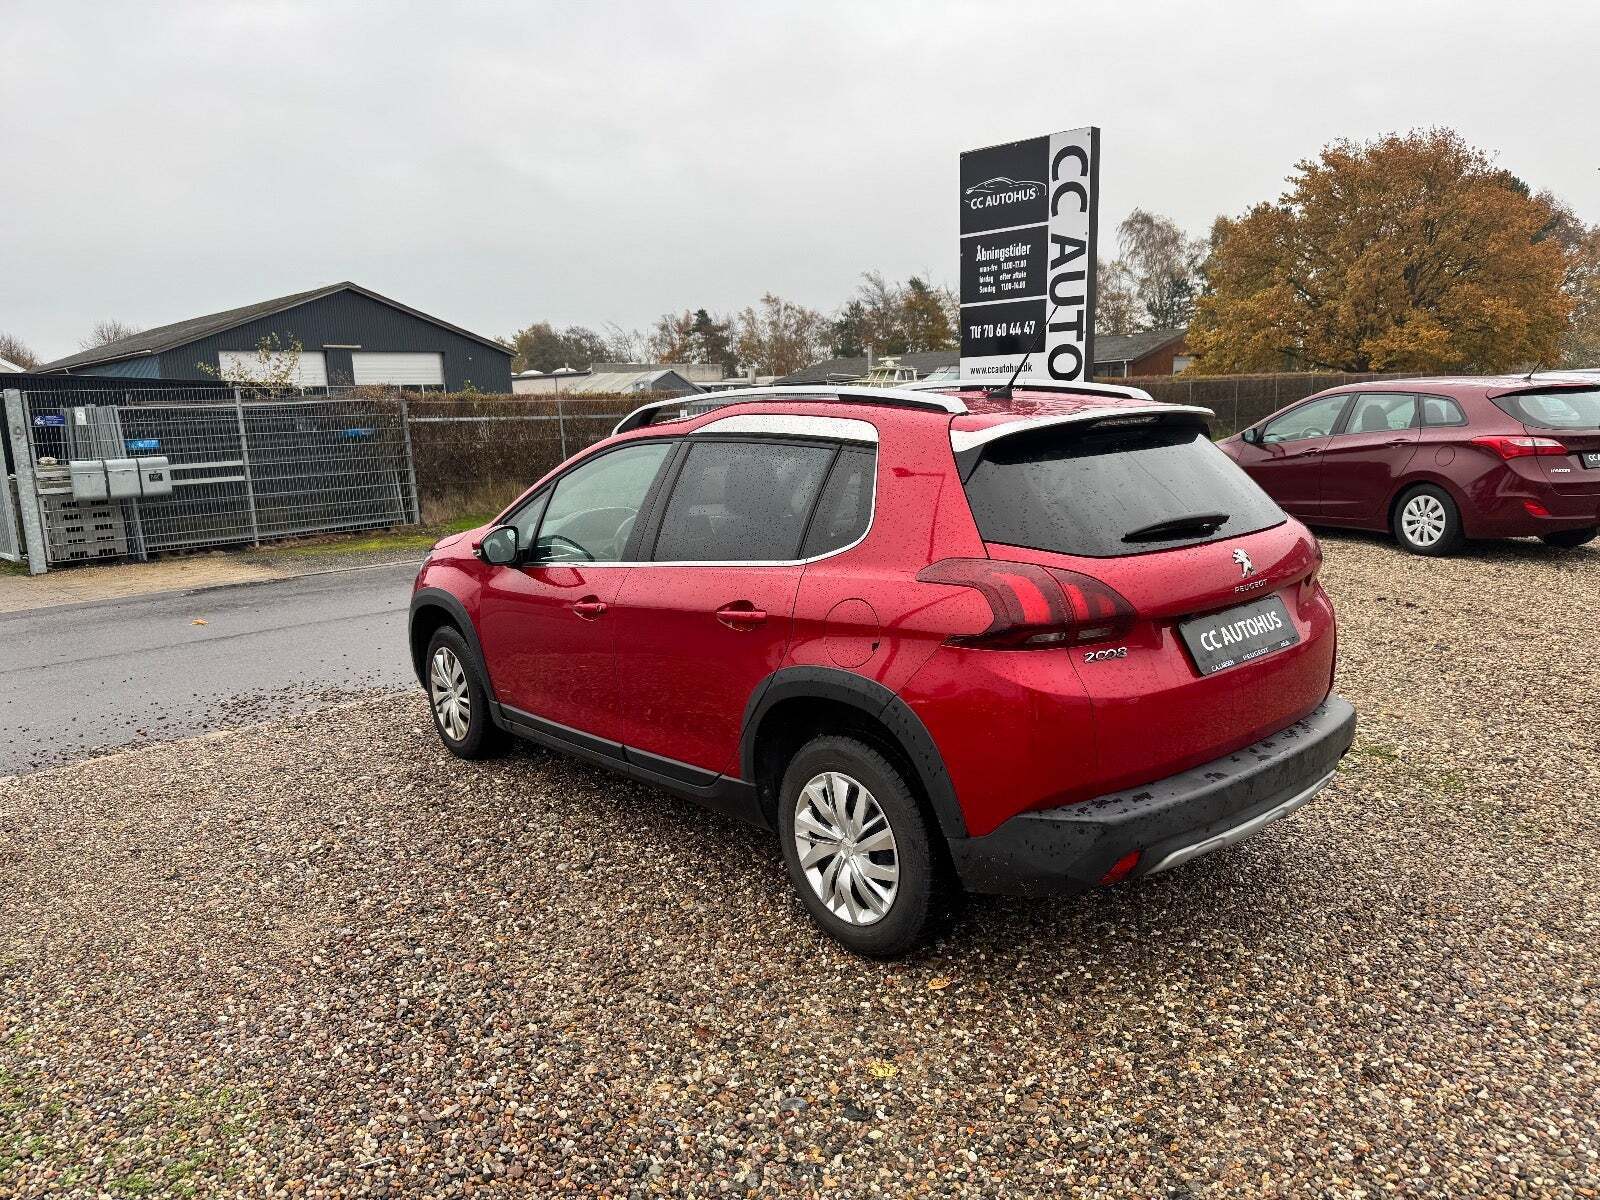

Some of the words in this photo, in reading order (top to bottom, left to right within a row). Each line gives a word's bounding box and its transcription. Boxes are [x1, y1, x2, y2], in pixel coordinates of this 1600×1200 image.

[1051, 144, 1089, 218] CC
[970, 196, 984, 210] CC
[985, 187, 1036, 208] AUTOHUS
[976, 242, 1031, 262] Åbningstider
[1047, 233, 1087, 382] AUTO
[969, 325, 982, 340] Tlf
[983, 324, 994, 339] 70
[996, 322, 1007, 337] 60
[1009, 321, 1022, 336] 44
[1023, 320, 1036, 335] 47
[970, 361, 1033, 375] www.ccautohu.dk
[1234, 578, 1268, 594] PEUGEOT
[1200, 629, 1223, 651] CC
[1223, 610, 1283, 646] AUTOHUS
[1084, 646, 1128, 664] 2008
[1242, 647, 1269, 660] PEUGEOT
